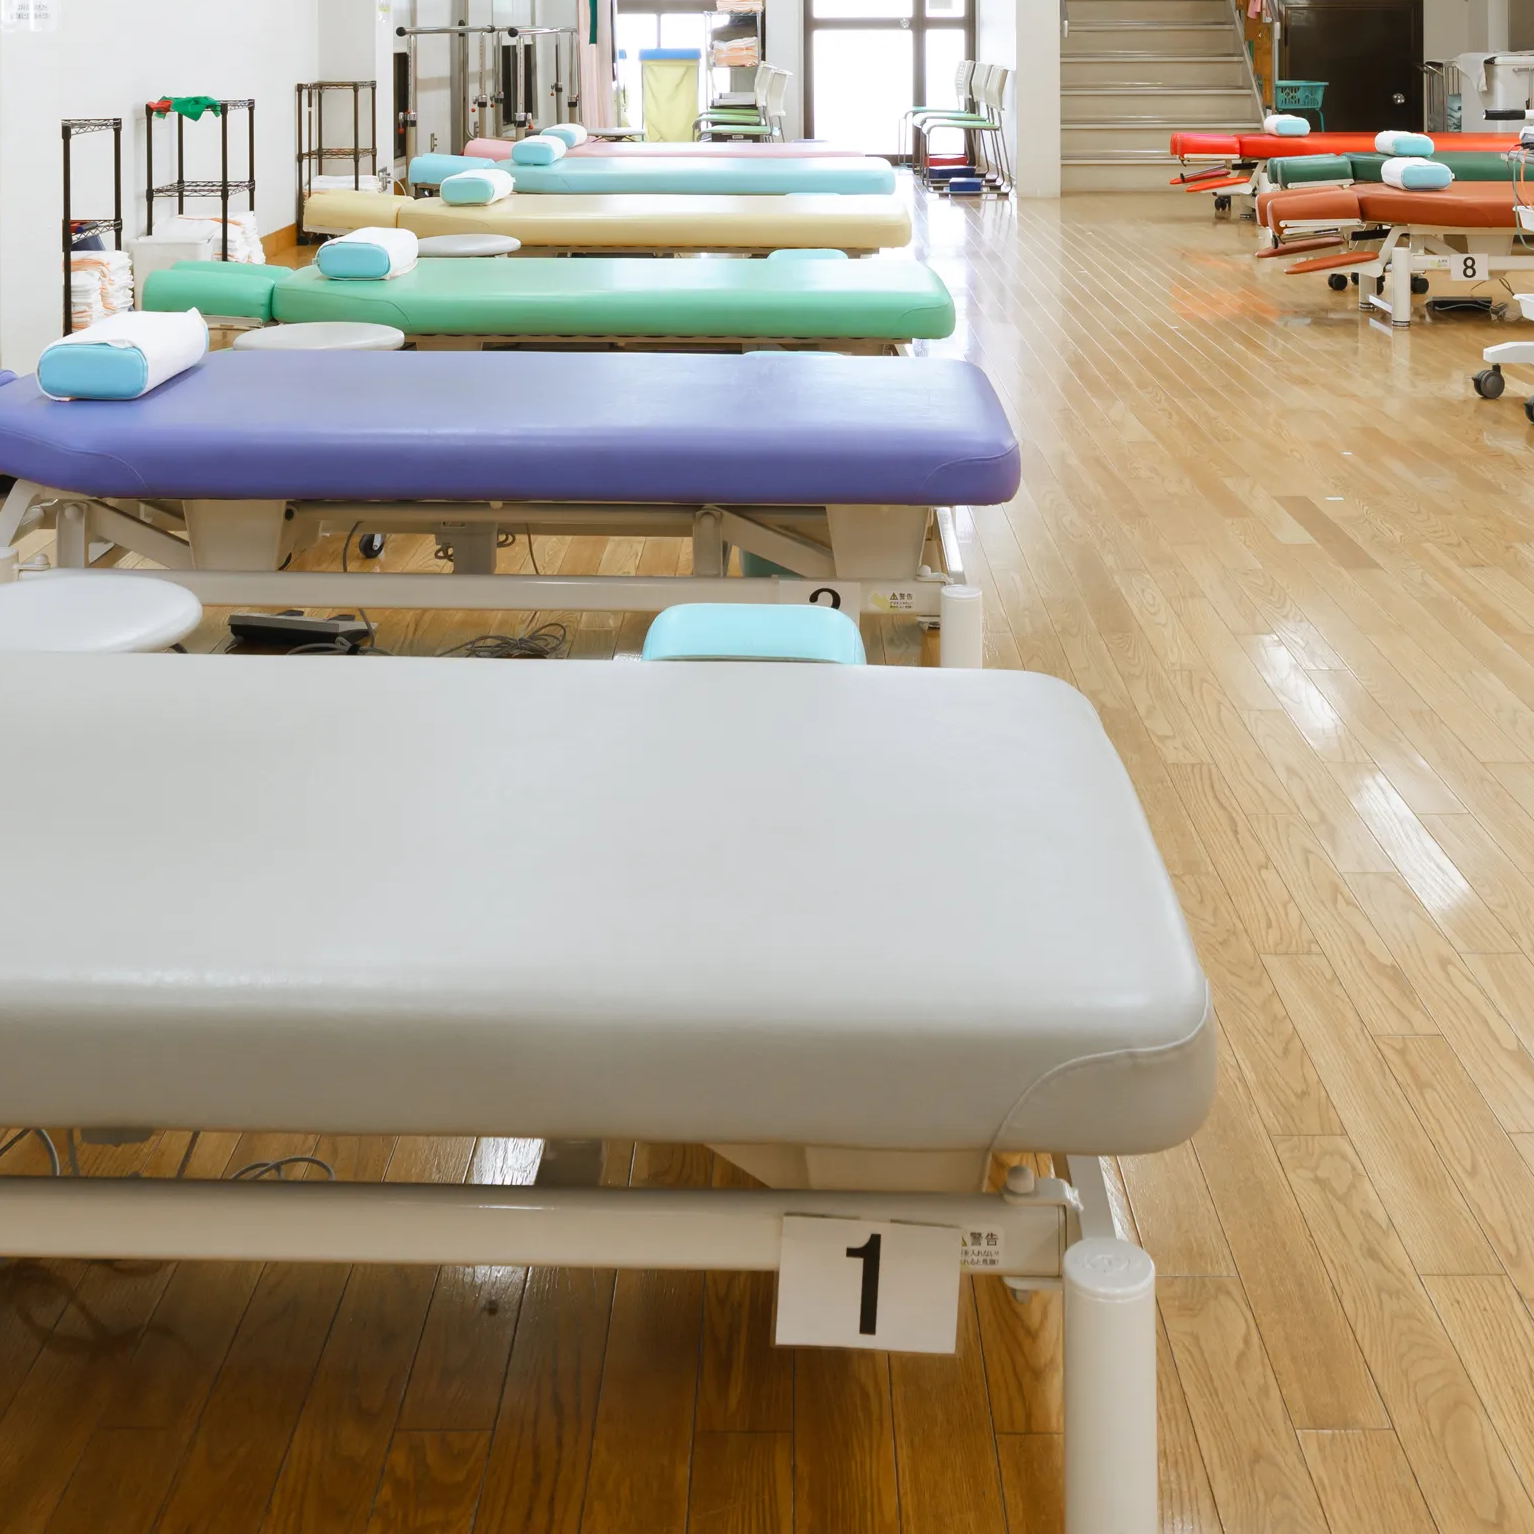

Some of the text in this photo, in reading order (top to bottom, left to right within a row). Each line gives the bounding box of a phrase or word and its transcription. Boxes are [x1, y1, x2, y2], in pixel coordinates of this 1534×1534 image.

[1463, 257, 1476, 278] 8
[970, 1232, 999, 1246] 警告
[846, 1233, 882, 1335] 1
